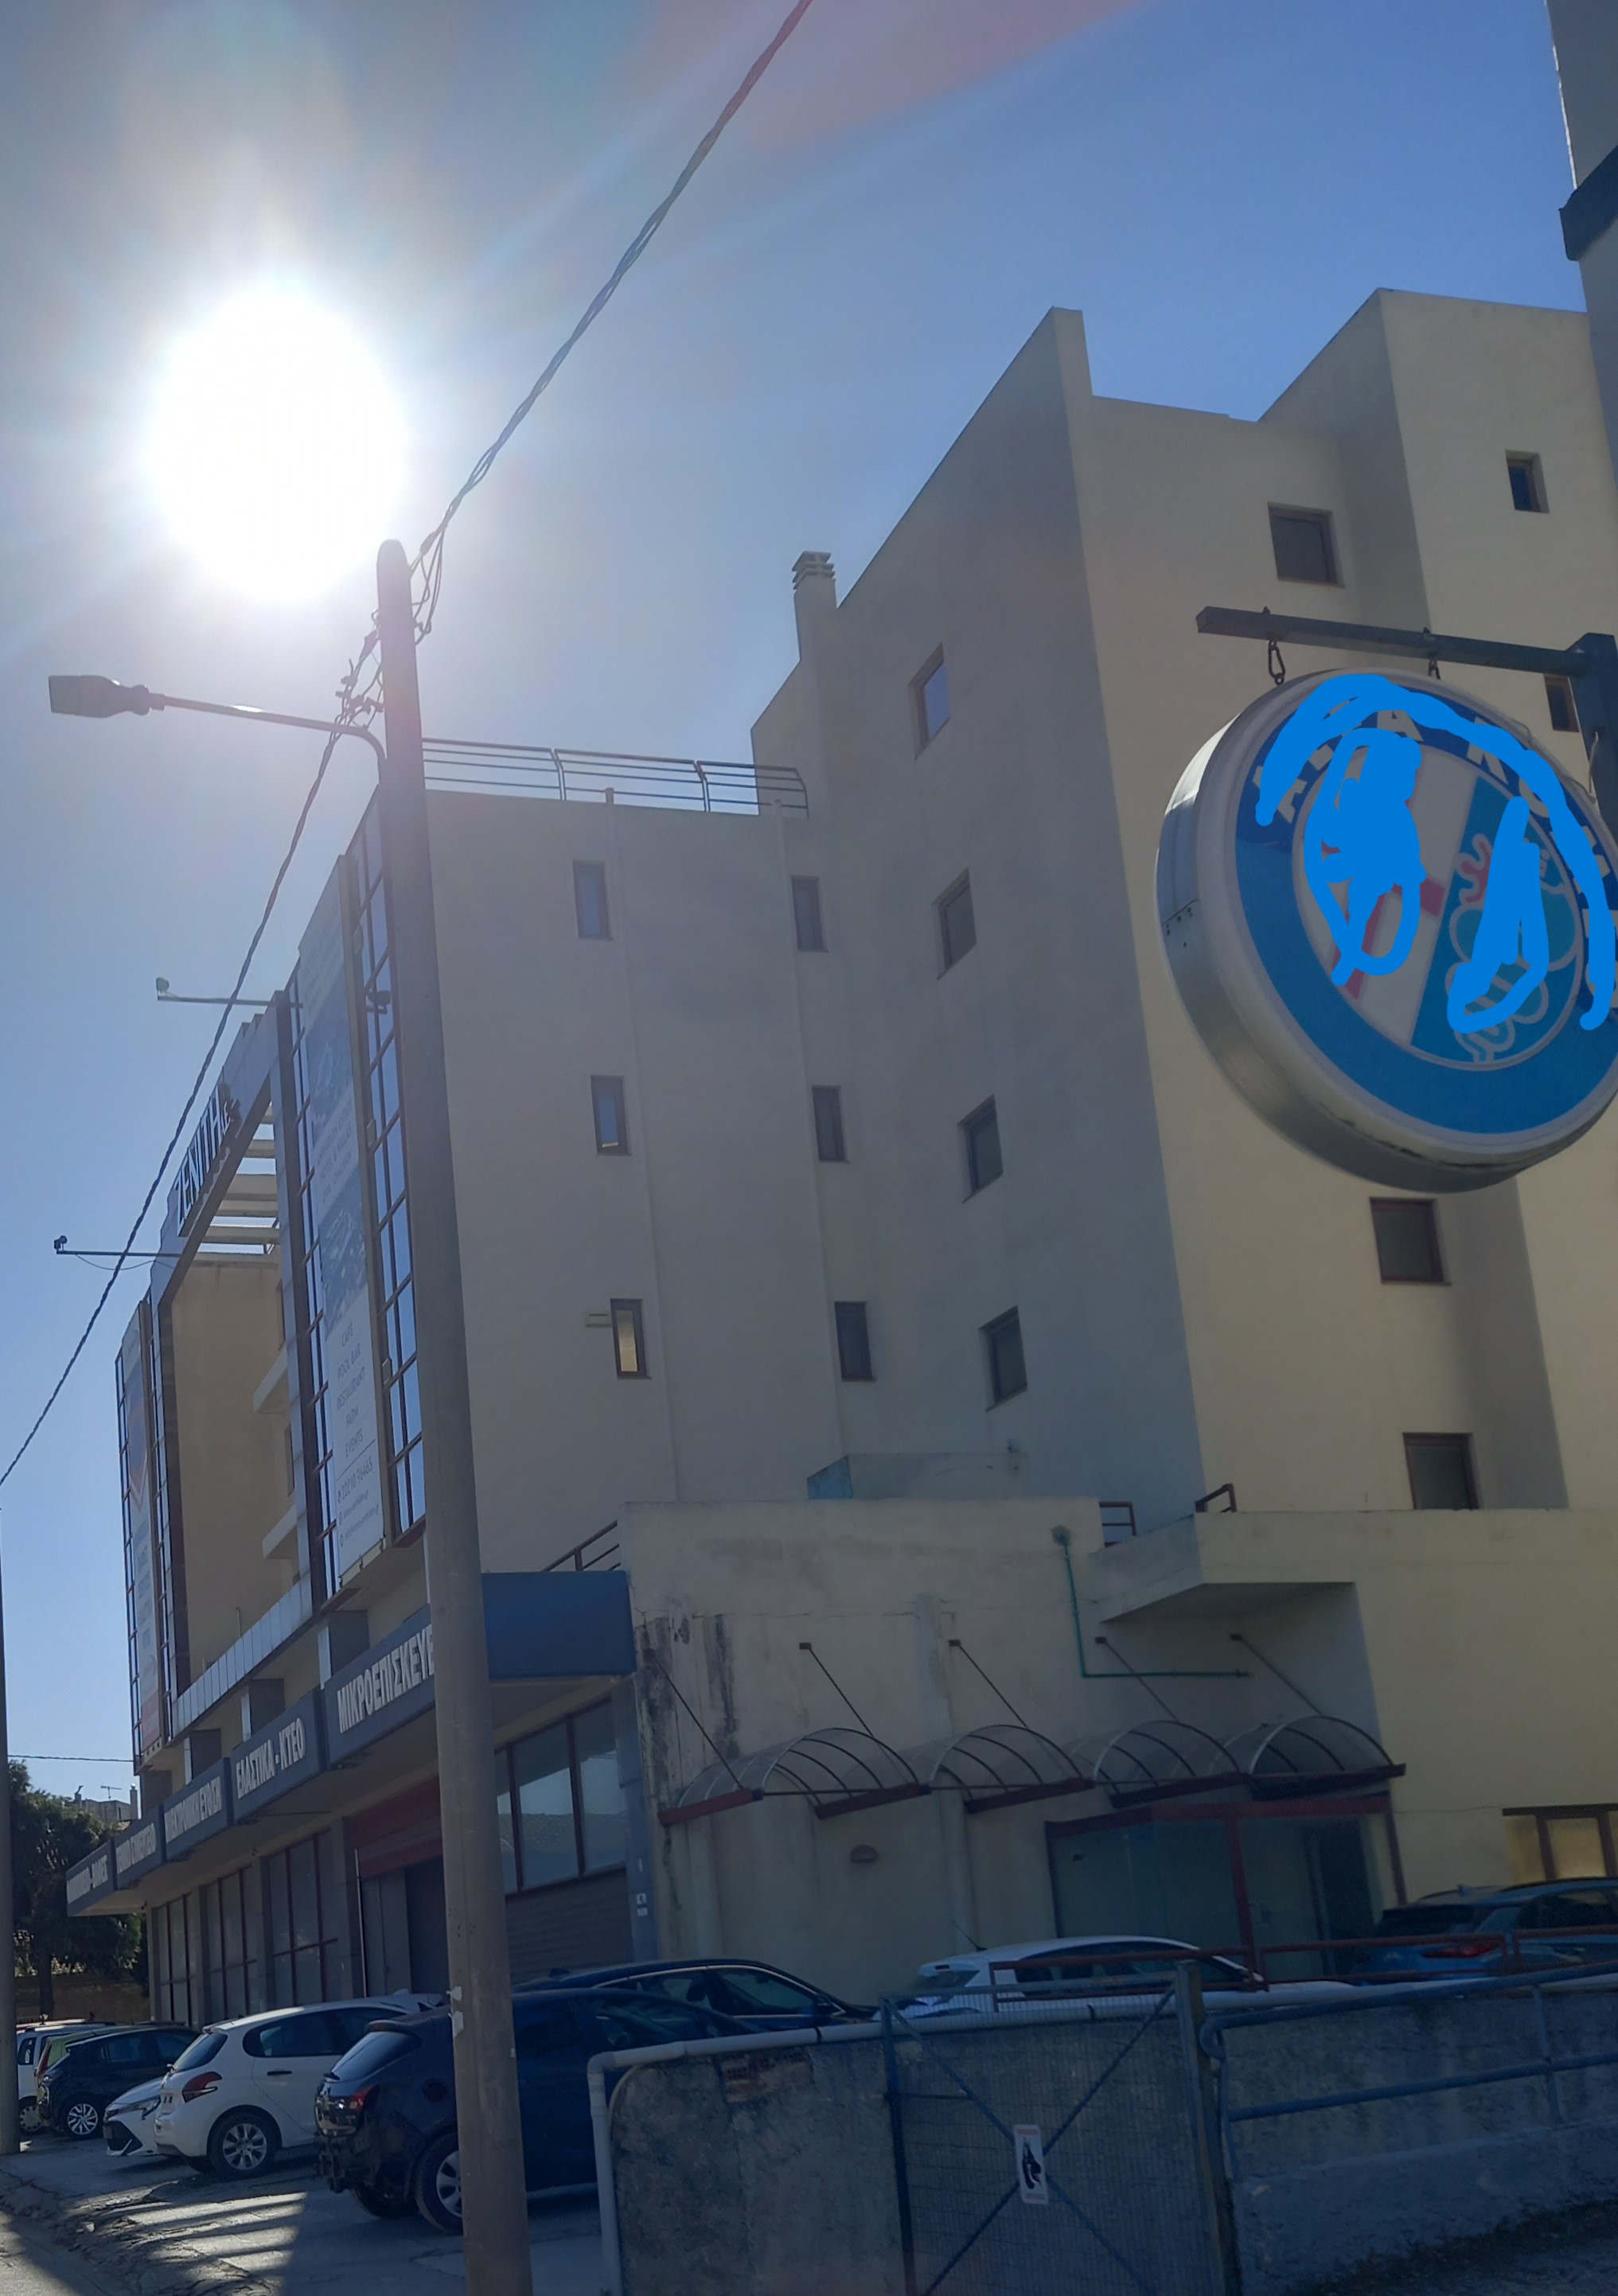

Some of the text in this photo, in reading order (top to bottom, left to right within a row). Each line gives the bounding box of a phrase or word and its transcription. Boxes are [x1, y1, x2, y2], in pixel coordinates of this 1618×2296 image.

[174, 1085, 223, 1238] ZENITH
[337, 1343, 361, 1382] POOL BAR
[345, 1427, 364, 1459] EVENTS
[236, 1739, 276, 1799] ΕΛΑΣΤΙΚΑ
[279, 1717, 306, 1771] ΚΤΕΟ
